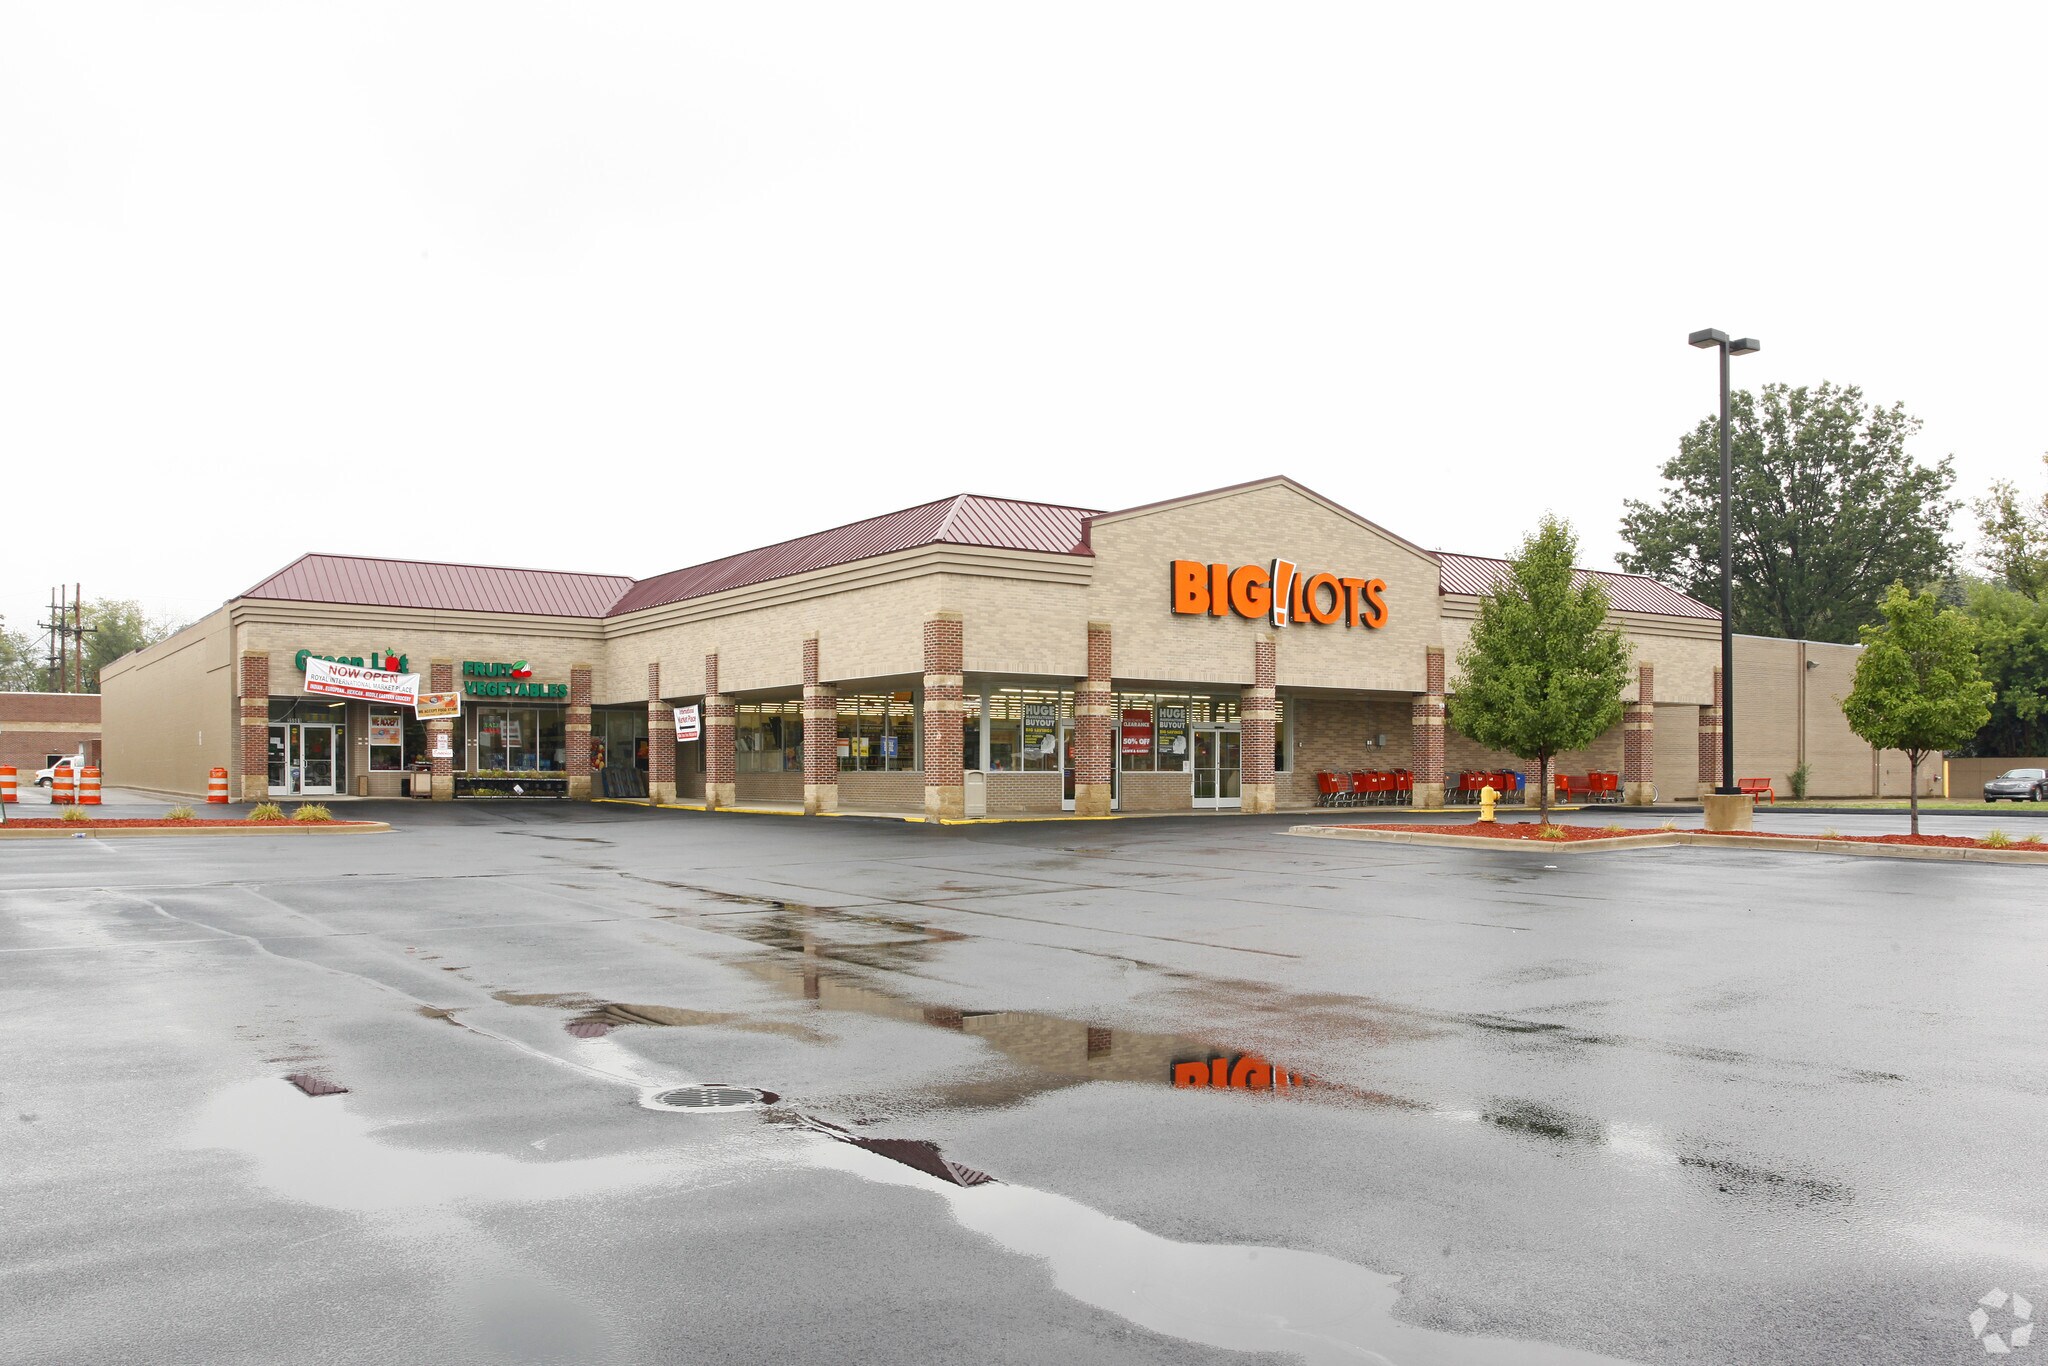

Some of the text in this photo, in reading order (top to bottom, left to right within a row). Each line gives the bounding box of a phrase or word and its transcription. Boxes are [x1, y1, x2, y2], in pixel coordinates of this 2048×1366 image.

[1289, 572, 1389, 629] LOTS
[328, 665, 399, 684] NOW OPEN
[463, 660, 512, 678] FRUIT
[310, 673, 413, 694] ROYAL INTERNATIONAL MARKET PLACE
[464, 681, 568, 698] VEGETABLES
[1025, 705, 1055, 716] HUGE
[1159, 708, 1185, 718] HUGE
[1025, 719, 1055, 727] BUYOUT
[1159, 721, 1186, 729] BUYOUT
